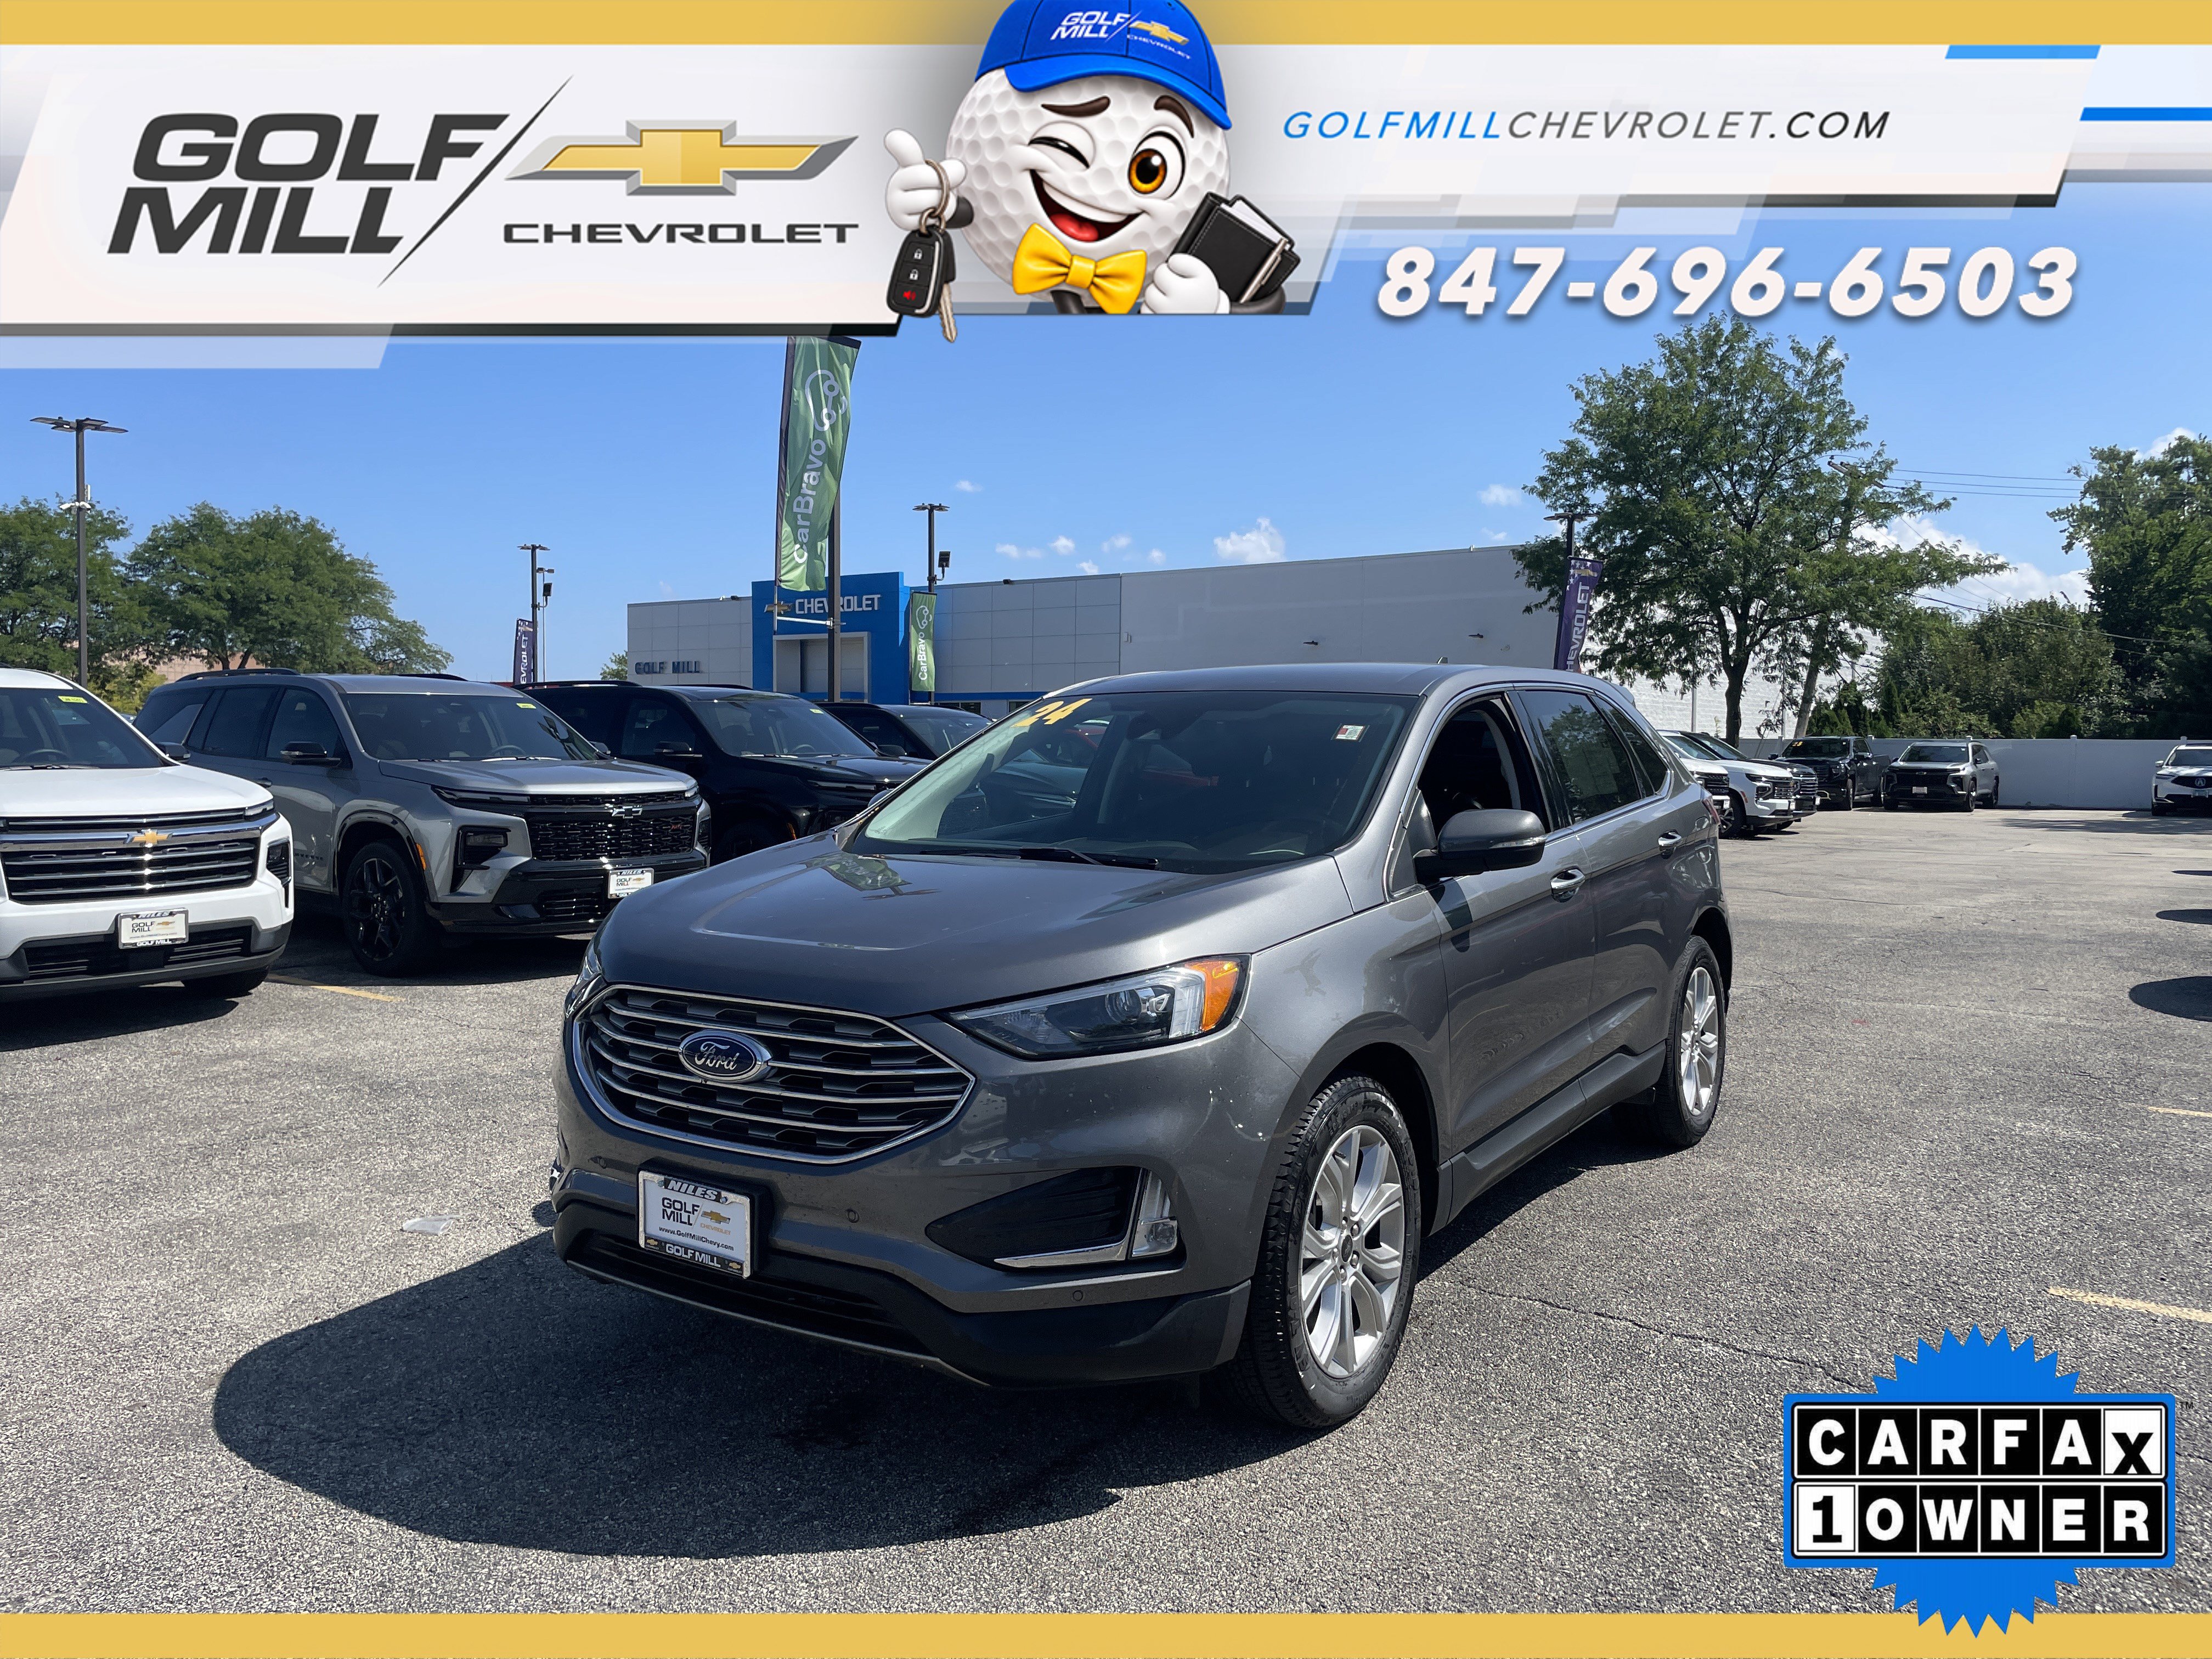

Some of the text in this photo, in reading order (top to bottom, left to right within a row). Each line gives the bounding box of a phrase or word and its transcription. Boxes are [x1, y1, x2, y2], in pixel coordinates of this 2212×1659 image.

[793, 438, 826, 564] CarBravo
[1565, 582, 1590, 672] HEVROLET
[635, 660, 701, 675] GOLF MILL
[917, 631, 928, 681] CarBravo
[694, 1041, 740, 1070] Ford
[667, 1180, 719, 1201] NILES
[661, 1197, 700, 1216] GOLF
[662, 1208, 694, 1226] MILL
[658, 1225, 735, 1251] www.GolfMillChevy.com
[699, 1222, 732, 1235] CHEVROLET
[665, 1243, 721, 1268] GOLF MILL
